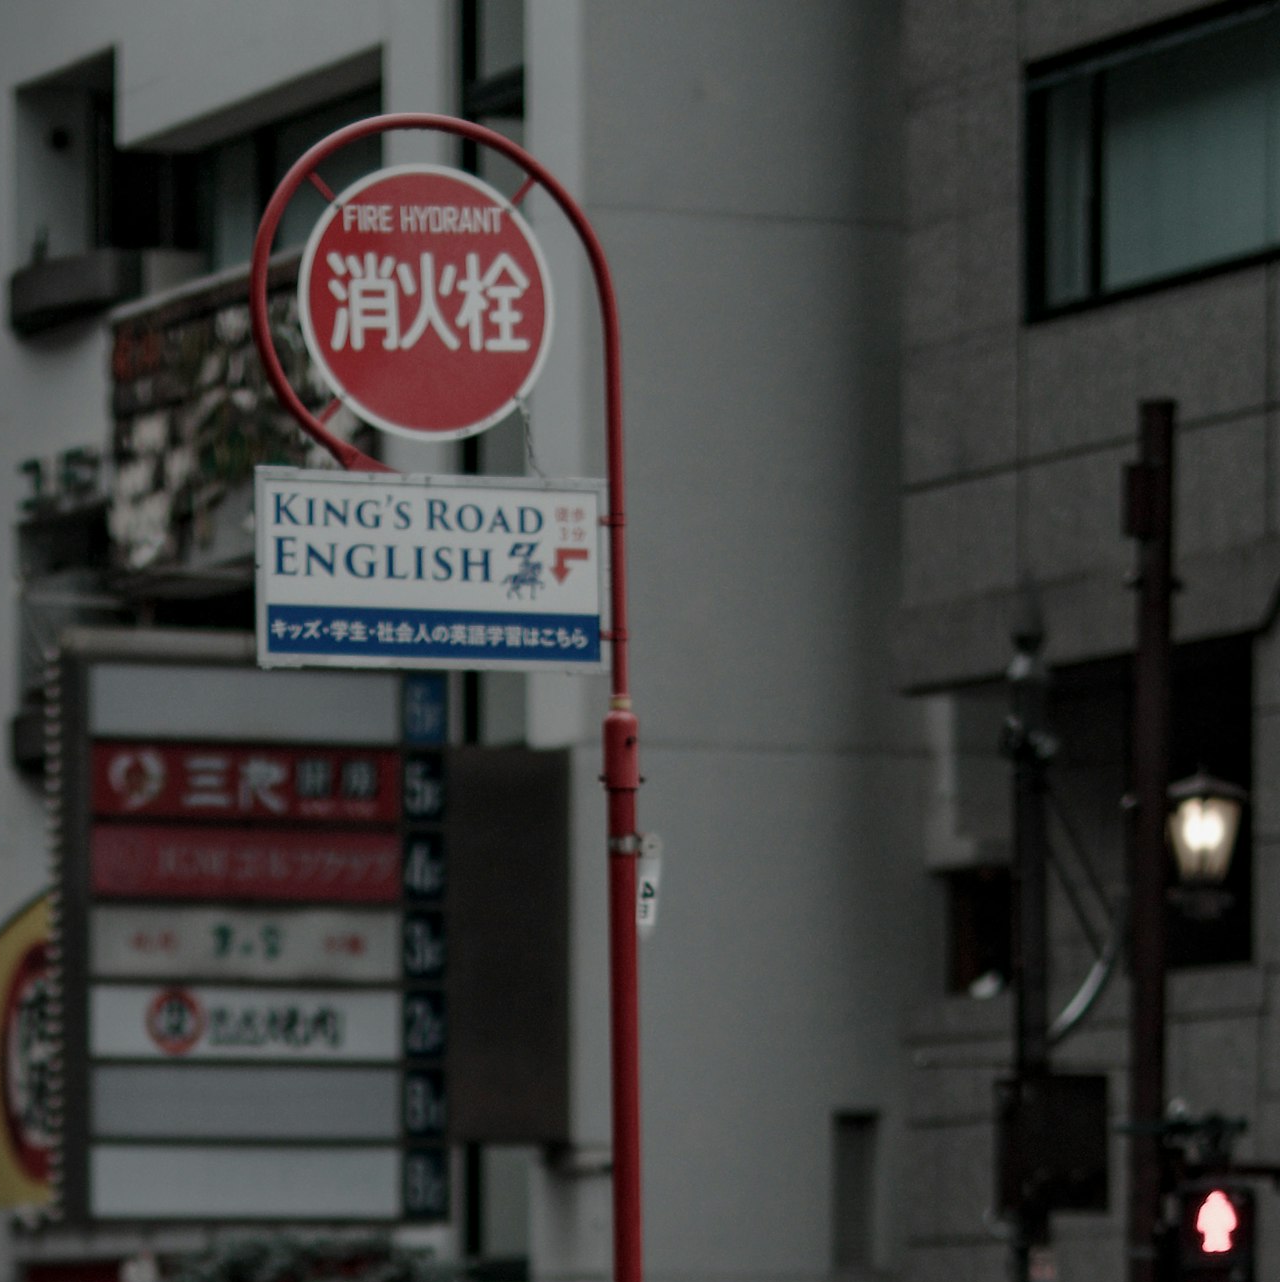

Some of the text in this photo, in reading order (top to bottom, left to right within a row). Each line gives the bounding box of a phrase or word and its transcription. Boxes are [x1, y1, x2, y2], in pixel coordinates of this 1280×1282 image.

[342, 204, 504, 234] FIRE HYDRANT
[326, 251, 531, 352] 消火栓
[272, 493, 544, 535] KING'S ROAD
[272, 536, 492, 583] ENGLISH
[271, 618, 589, 650] キッズ・学生・社会人の英語学習はこちら
